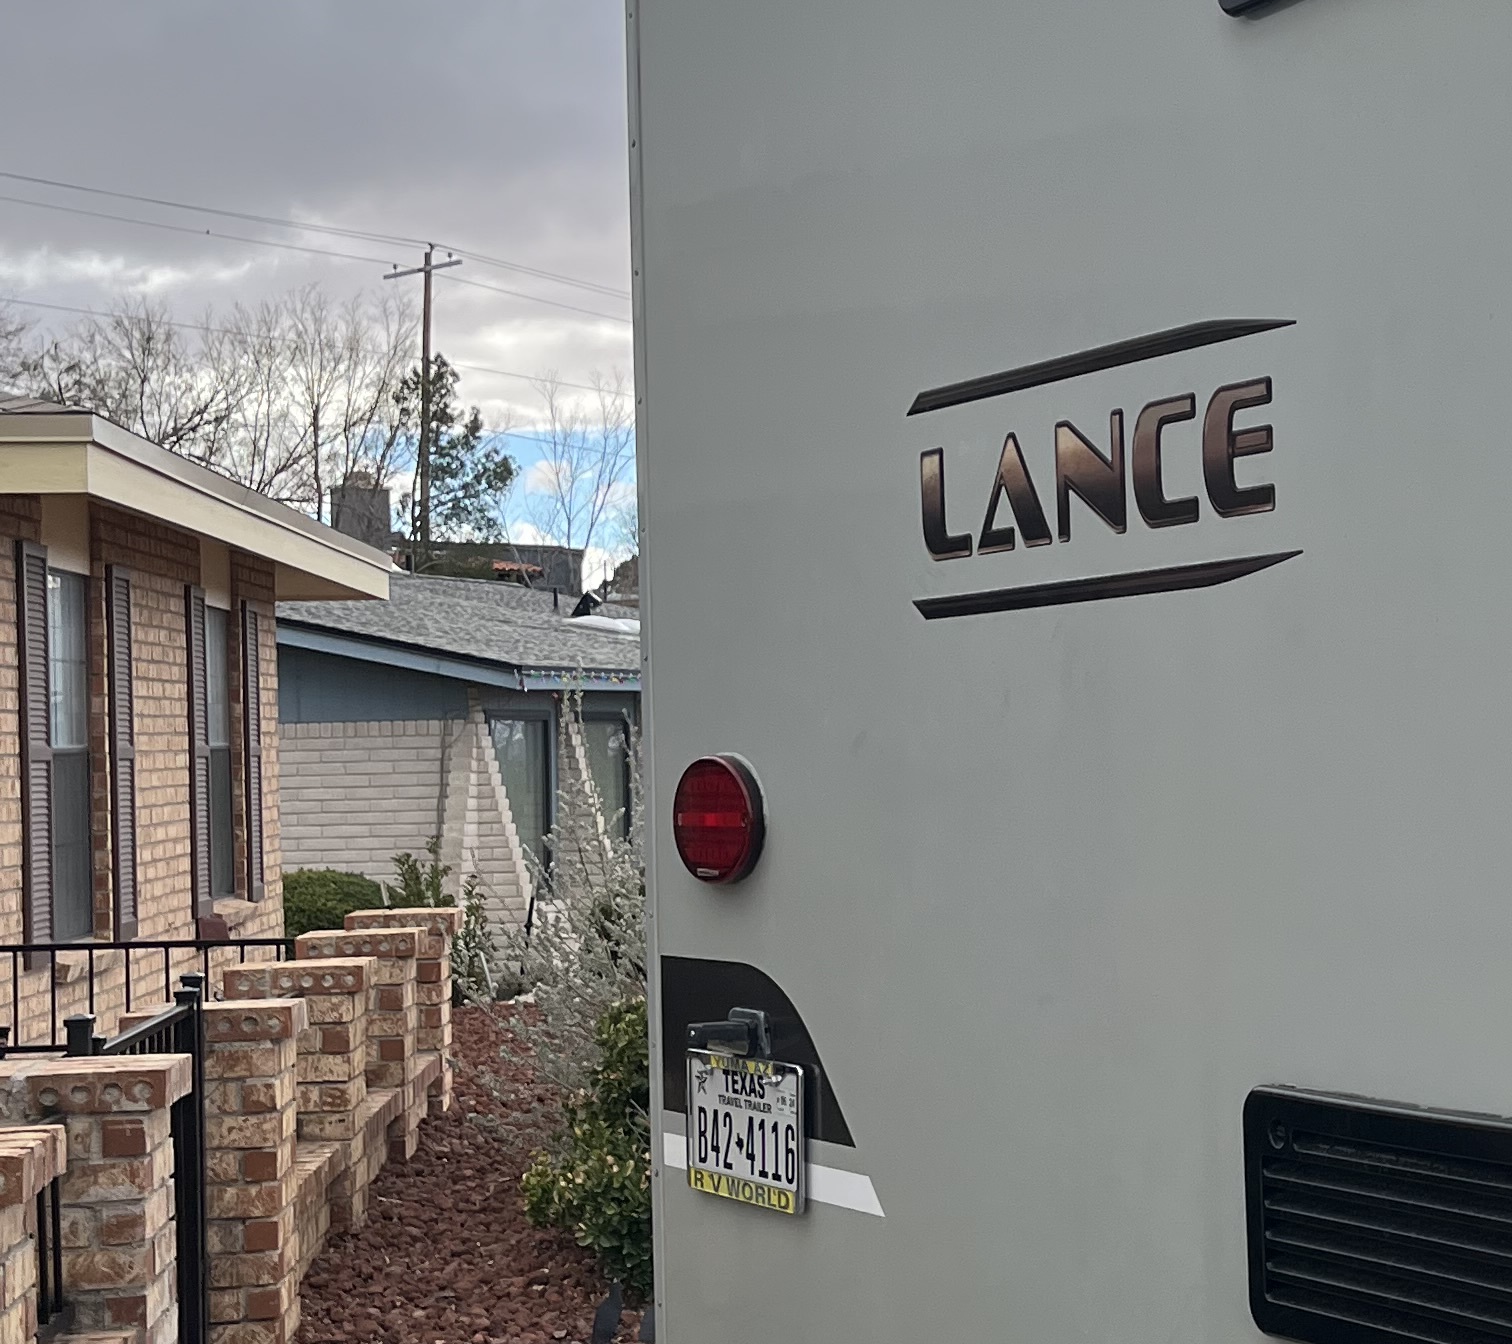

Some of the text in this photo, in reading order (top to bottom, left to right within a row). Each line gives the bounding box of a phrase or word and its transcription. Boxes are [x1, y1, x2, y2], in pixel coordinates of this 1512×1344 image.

[920, 375, 1276, 562] LANCE
[722, 1069, 766, 1099] TEXAS
[718, 1094, 742, 1109] TRAVEL
[744, 1099, 773, 1114] TRAILER
[727, 1176, 790, 1211] WORLD
